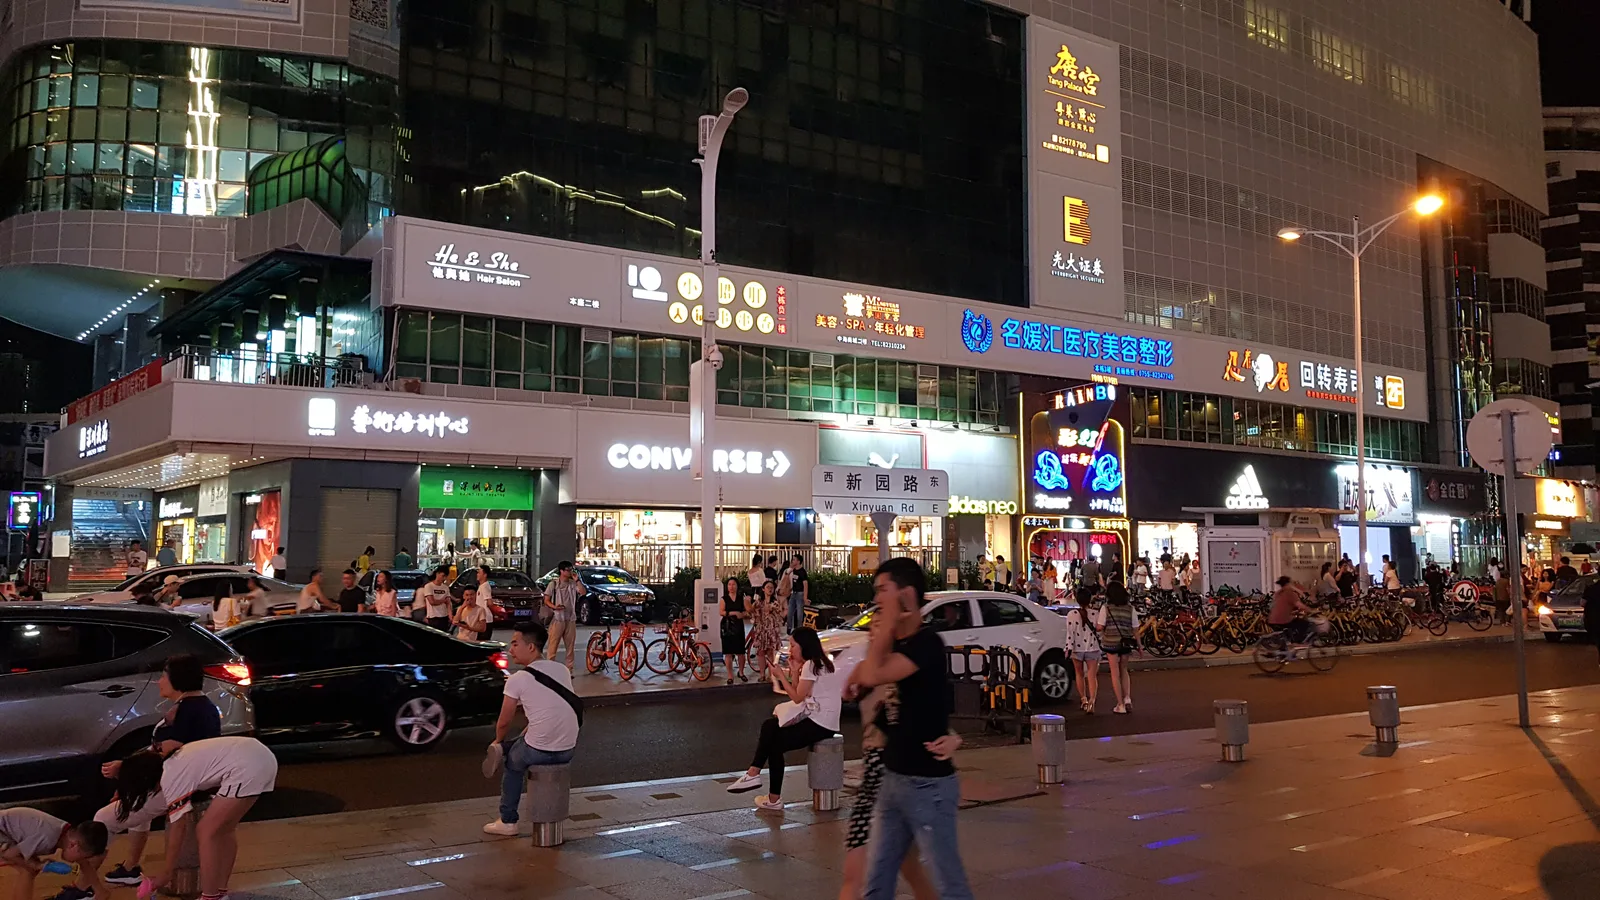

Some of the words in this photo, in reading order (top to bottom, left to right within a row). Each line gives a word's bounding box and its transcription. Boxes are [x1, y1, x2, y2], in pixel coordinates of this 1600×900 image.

[1048, 76, 1063, 89] Tang
[1064, 80, 1082, 93] Palace
[435, 244, 459, 264] He
[464, 252, 480, 266] &
[484, 252, 519, 271] She
[1052, 250, 1104, 277] 光大证券
[477, 273, 495, 284] Hair
[496, 276, 521, 287] Salon
[815, 314, 838, 329] 美容
[845, 319, 866, 331] SPA
[874, 321, 925, 339] 年轻化管理
[1001, 318, 1174, 367] 名媛汇医疗美容整形
[607, 443, 763, 474] CONVRSE
[824, 471, 834, 483] 西
[846, 473, 919, 493] 新园路
[930, 476, 939, 488] 东
[824, 501, 834, 510] W
[852, 502, 894, 514] Xinyuan
[901, 503, 915, 513] Rd
[932, 504, 939, 513] E
[988, 499, 1018, 515] neo
[1457, 587, 1475, 599] 40
